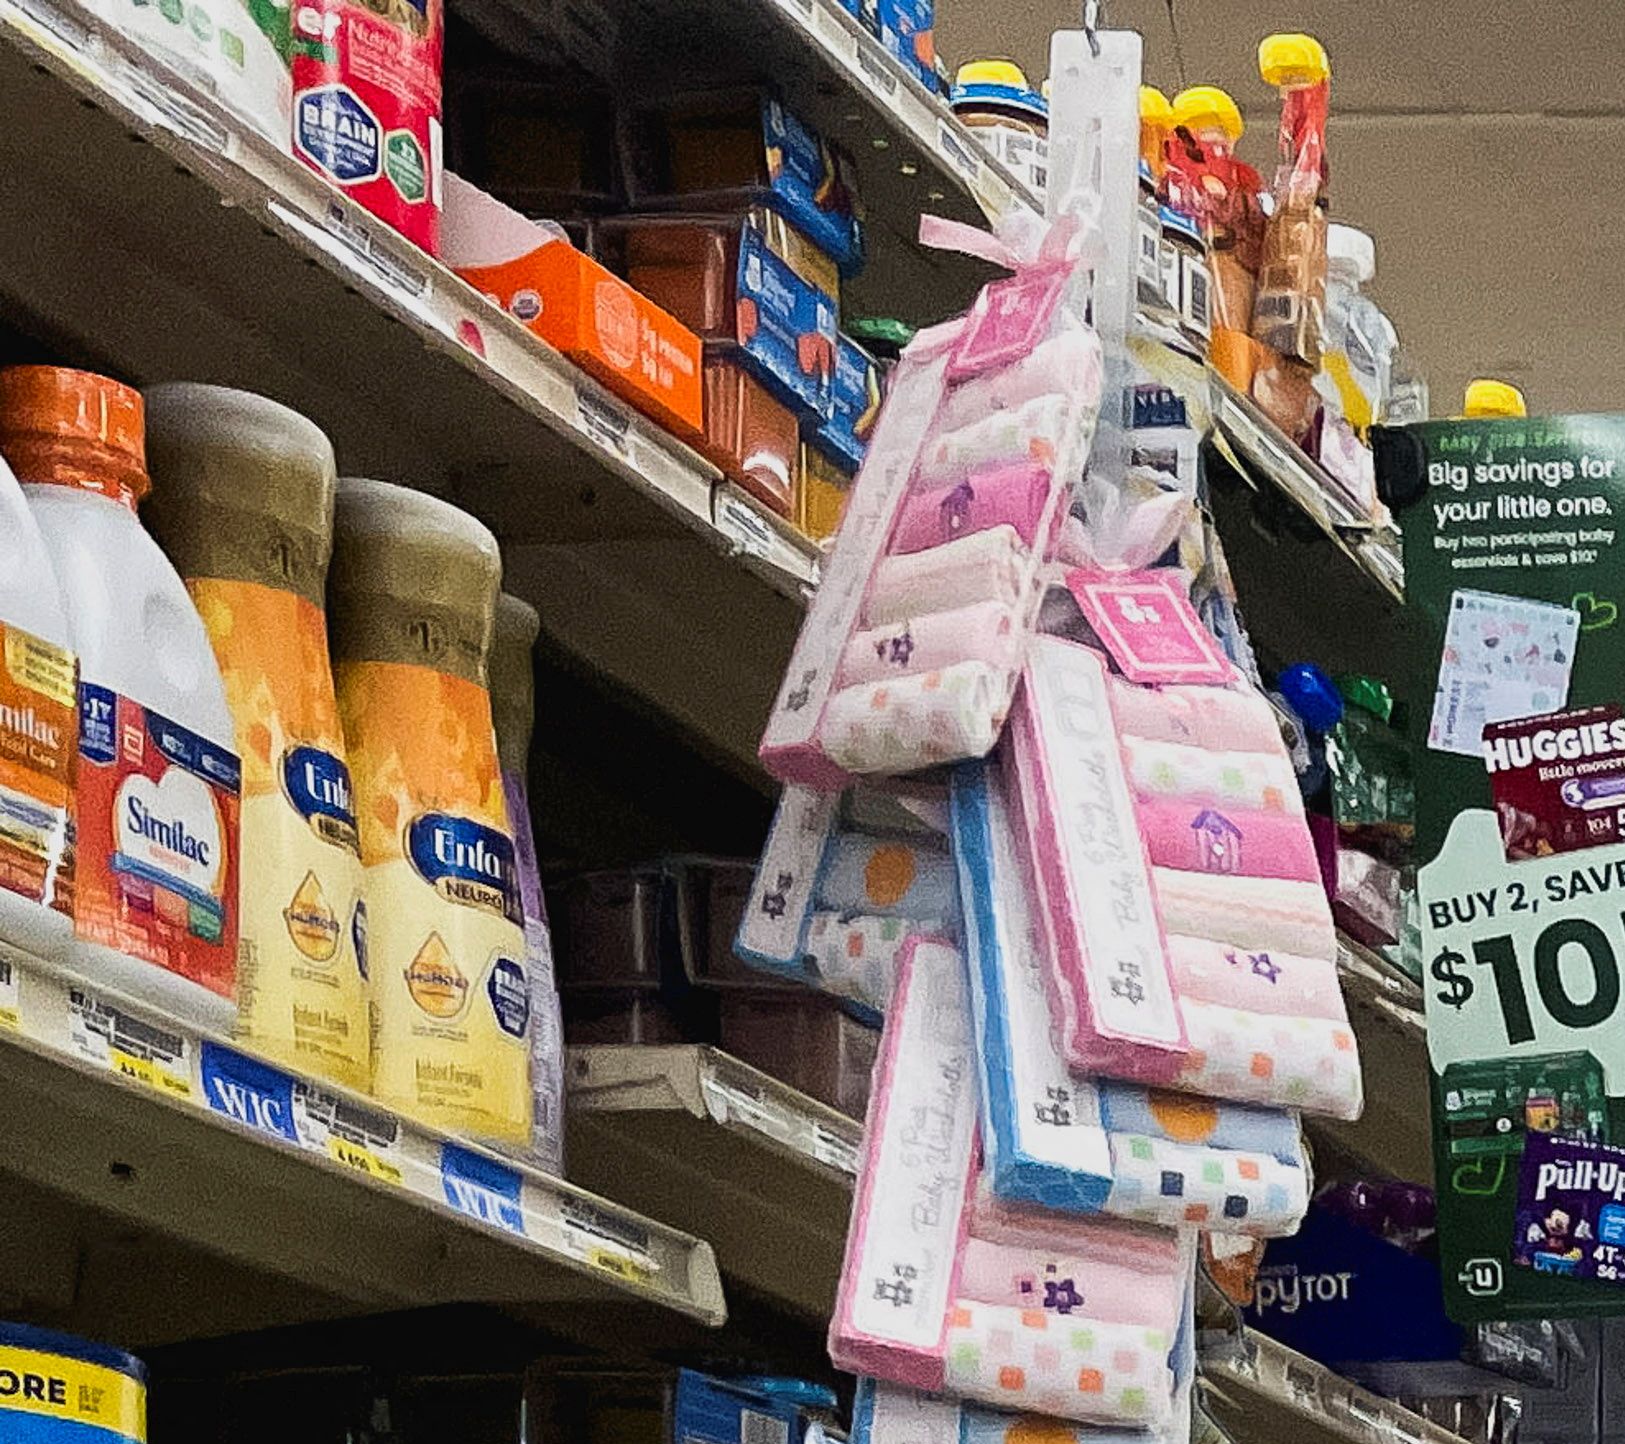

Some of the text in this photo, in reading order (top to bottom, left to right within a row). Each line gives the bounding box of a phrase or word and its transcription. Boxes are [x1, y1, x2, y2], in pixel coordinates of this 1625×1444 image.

[303, 102, 378, 148] BRAIN
[1428, 455, 1616, 490] Big savings for
[1434, 495, 1612, 530] your little one.
[1489, 530, 1576, 550] participating
[127, 795, 210, 866] Similac
[1429, 887, 1498, 929] BUY
[1506, 881, 1539, 914] 2,
[214, 1077, 291, 1141] WIC
